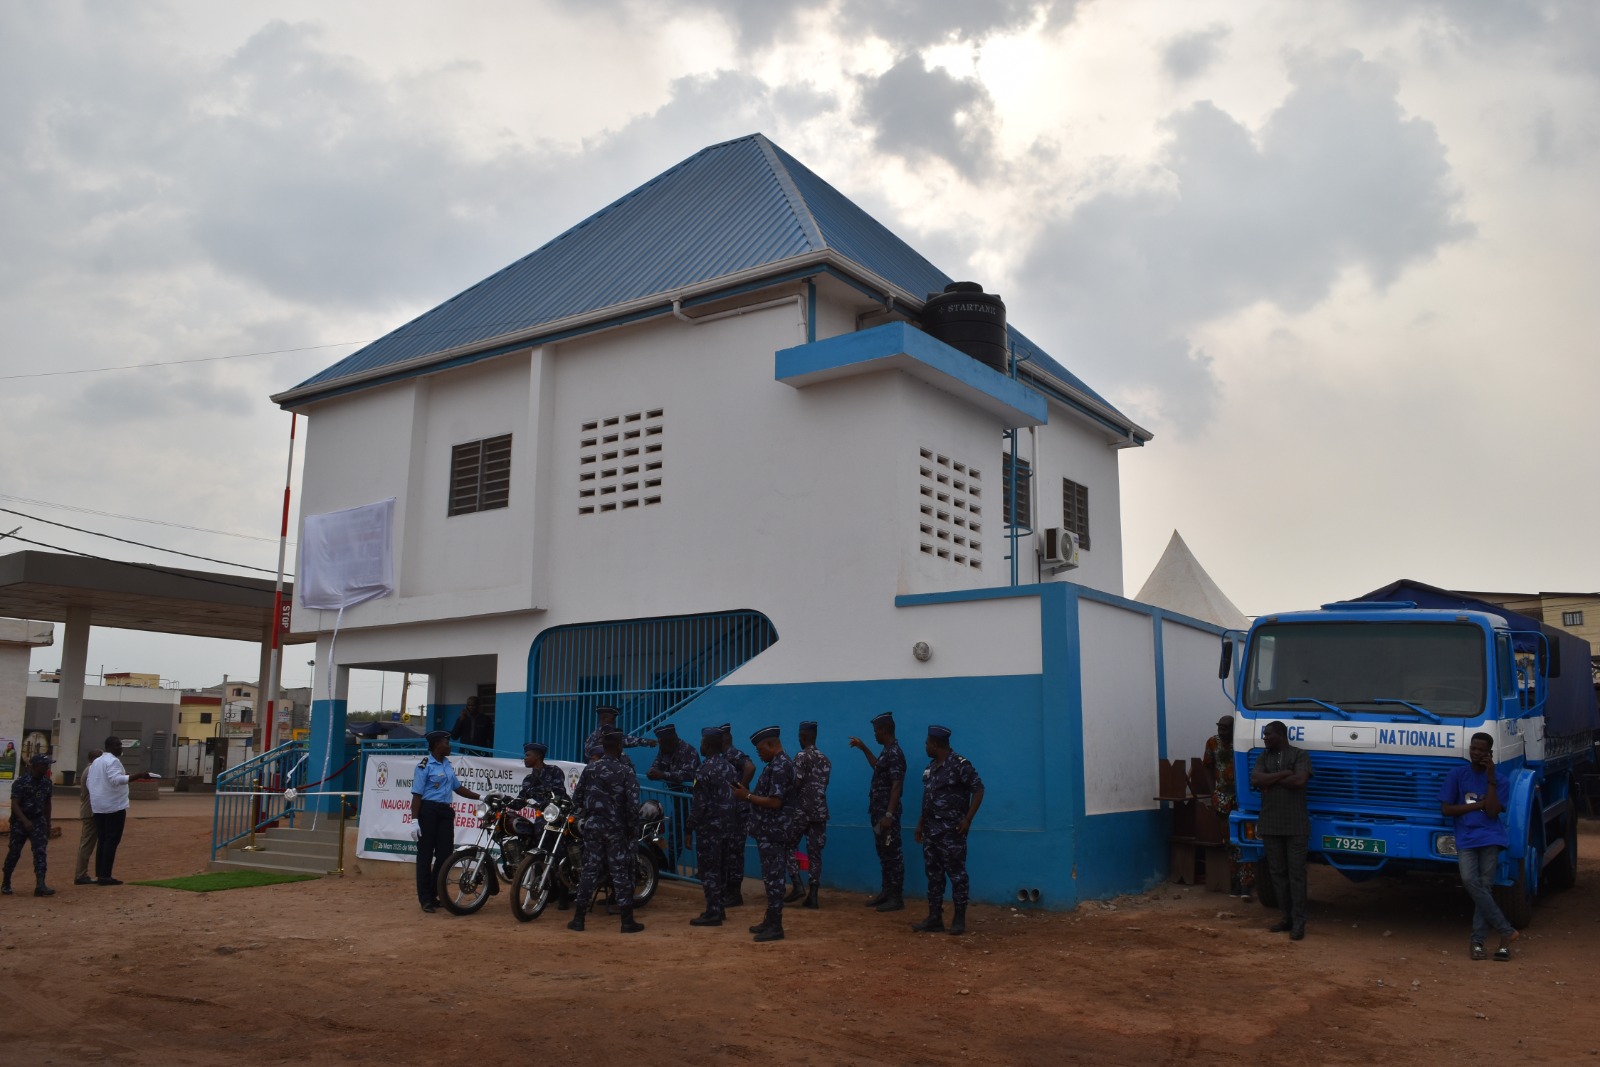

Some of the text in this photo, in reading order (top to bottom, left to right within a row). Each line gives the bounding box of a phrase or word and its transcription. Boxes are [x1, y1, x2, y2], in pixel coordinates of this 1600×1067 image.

[282, 605, 291, 628] STOP
[1379, 729, 1455, 748] NATIONALE
[475, 768, 513, 780] TOGOLAISE
[396, 779, 414, 788] MINIST
[494, 783, 522, 794] PROTECT
[381, 799, 412, 810] INAUGUR
[455, 813, 475, 828] ÈRES
[1335, 838, 1364, 850] 7925
